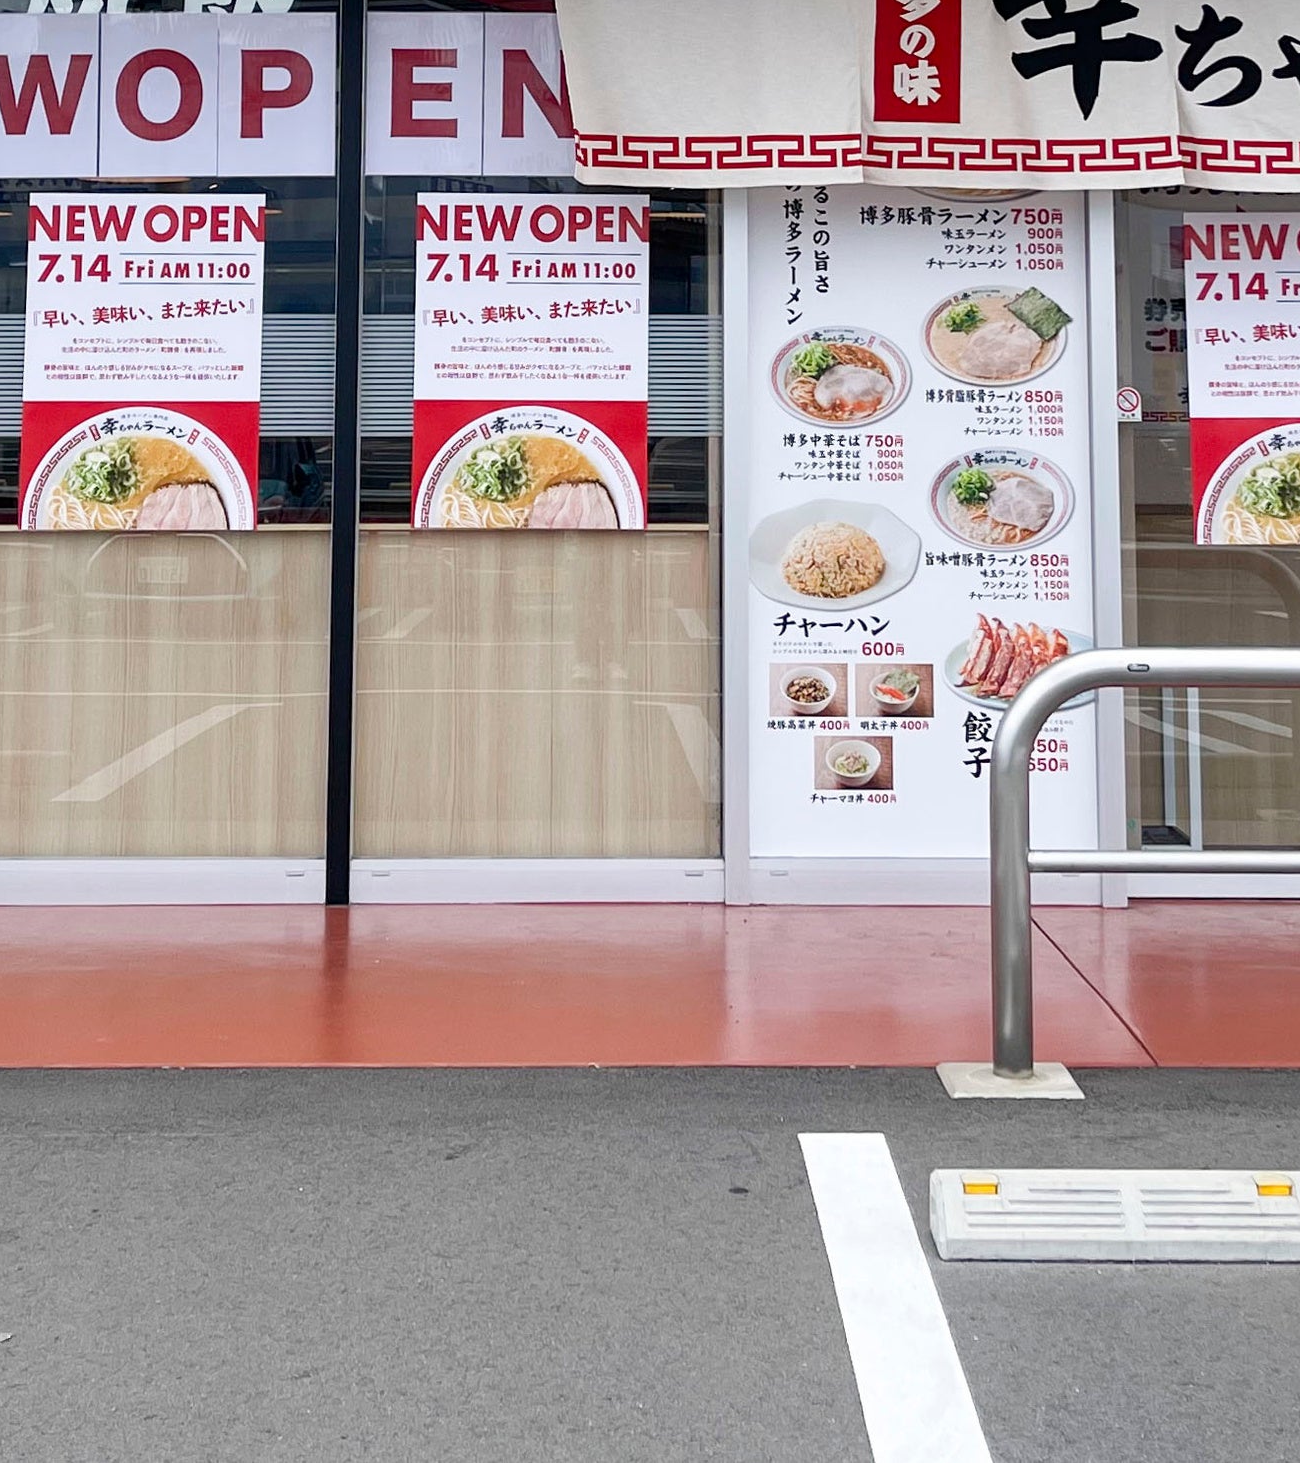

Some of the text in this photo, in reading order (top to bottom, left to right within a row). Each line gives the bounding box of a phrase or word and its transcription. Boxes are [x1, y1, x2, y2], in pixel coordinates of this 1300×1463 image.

[116, 48, 571, 142] OPEN
[28, 205, 266, 242] NEW OPEN
[416, 205, 649, 242] NEW OPEN
[859, 206, 1063, 226] 博多豚骨ラーメン 750円
[941, 228, 1063, 240] 味玉ラーメン 900円
[945, 244, 1007, 254] ワンタンメン
[1183, 224, 1290, 260] NEW
[38, 254, 251, 282] 7.14 Fri AM 11:00
[426, 254, 636, 282] 7.14 Fri AM 11:00
[925, 258, 1007, 270] チャーシューメン
[1196, 272, 1269, 301] 7.14
[1024, 390, 1063, 403] 850円
[783, 434, 903, 447] 博多中華そば 750円
[926, 552, 1069, 567] 旨味噌豚骨ラーメン 850円
[773, 612, 890, 637] チャーハン
[862, 642, 904, 656] 600円
[820, 721, 850, 730] 400円
[901, 721, 929, 730] 400円
[963, 711, 994, 778] 餃子
[1034, 739, 1068, 752] 50円
[867, 794, 896, 803] 400円
